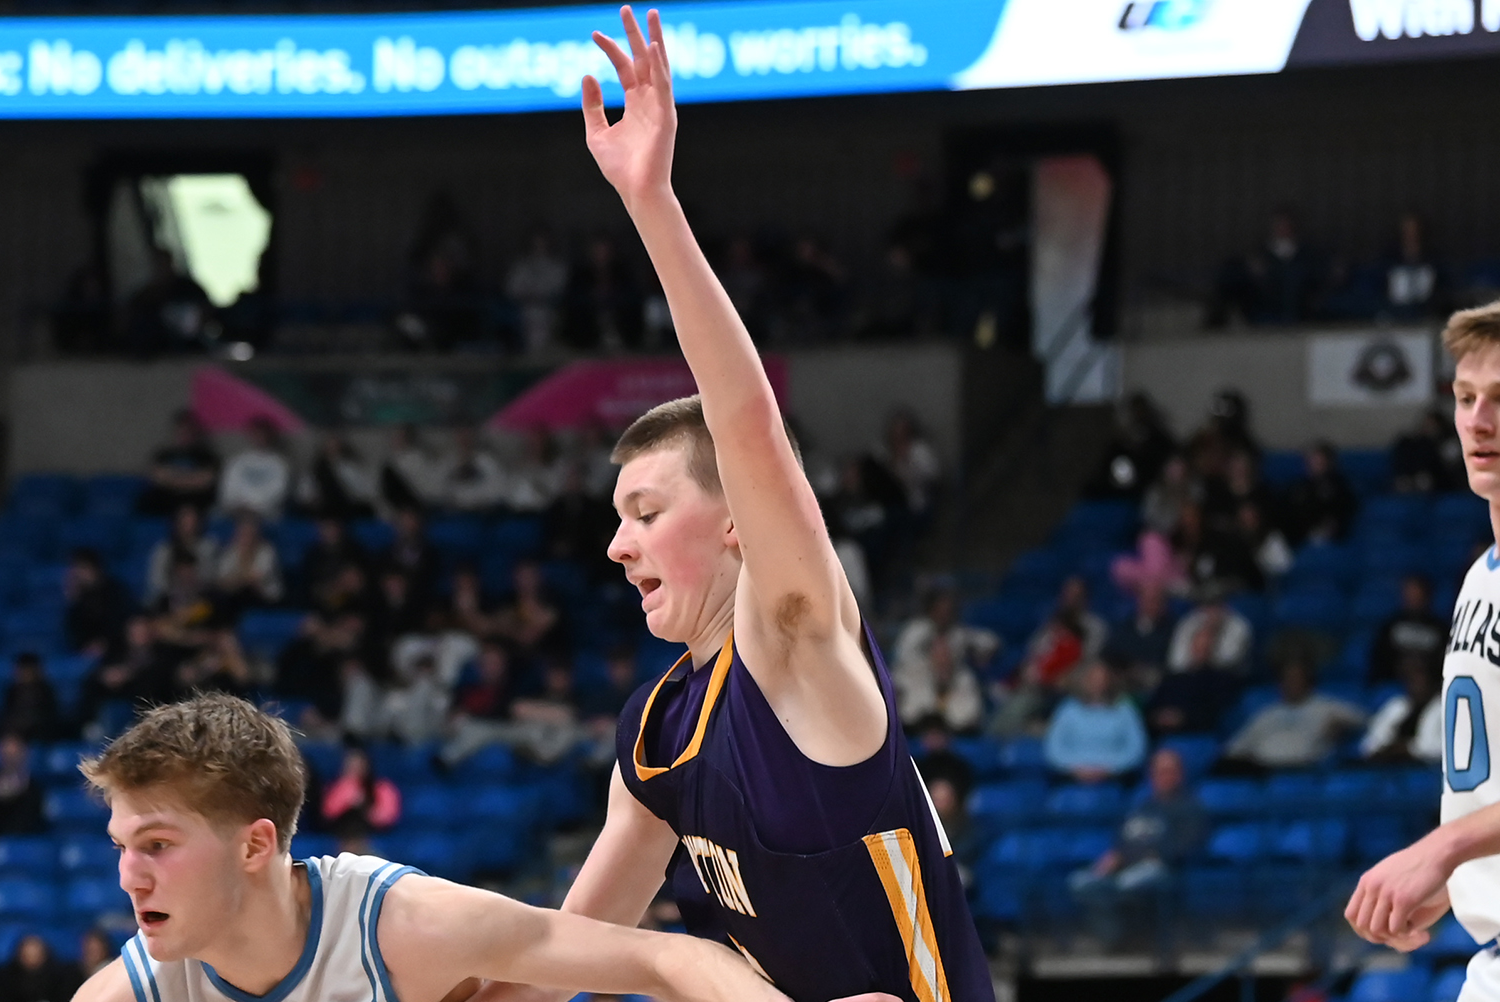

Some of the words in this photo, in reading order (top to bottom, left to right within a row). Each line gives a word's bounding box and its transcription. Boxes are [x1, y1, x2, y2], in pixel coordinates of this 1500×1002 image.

[28, 38, 101, 96] No
[106, 37, 366, 95] deliveries.
[372, 35, 445, 93] No
[729, 12, 928, 76] worries.
